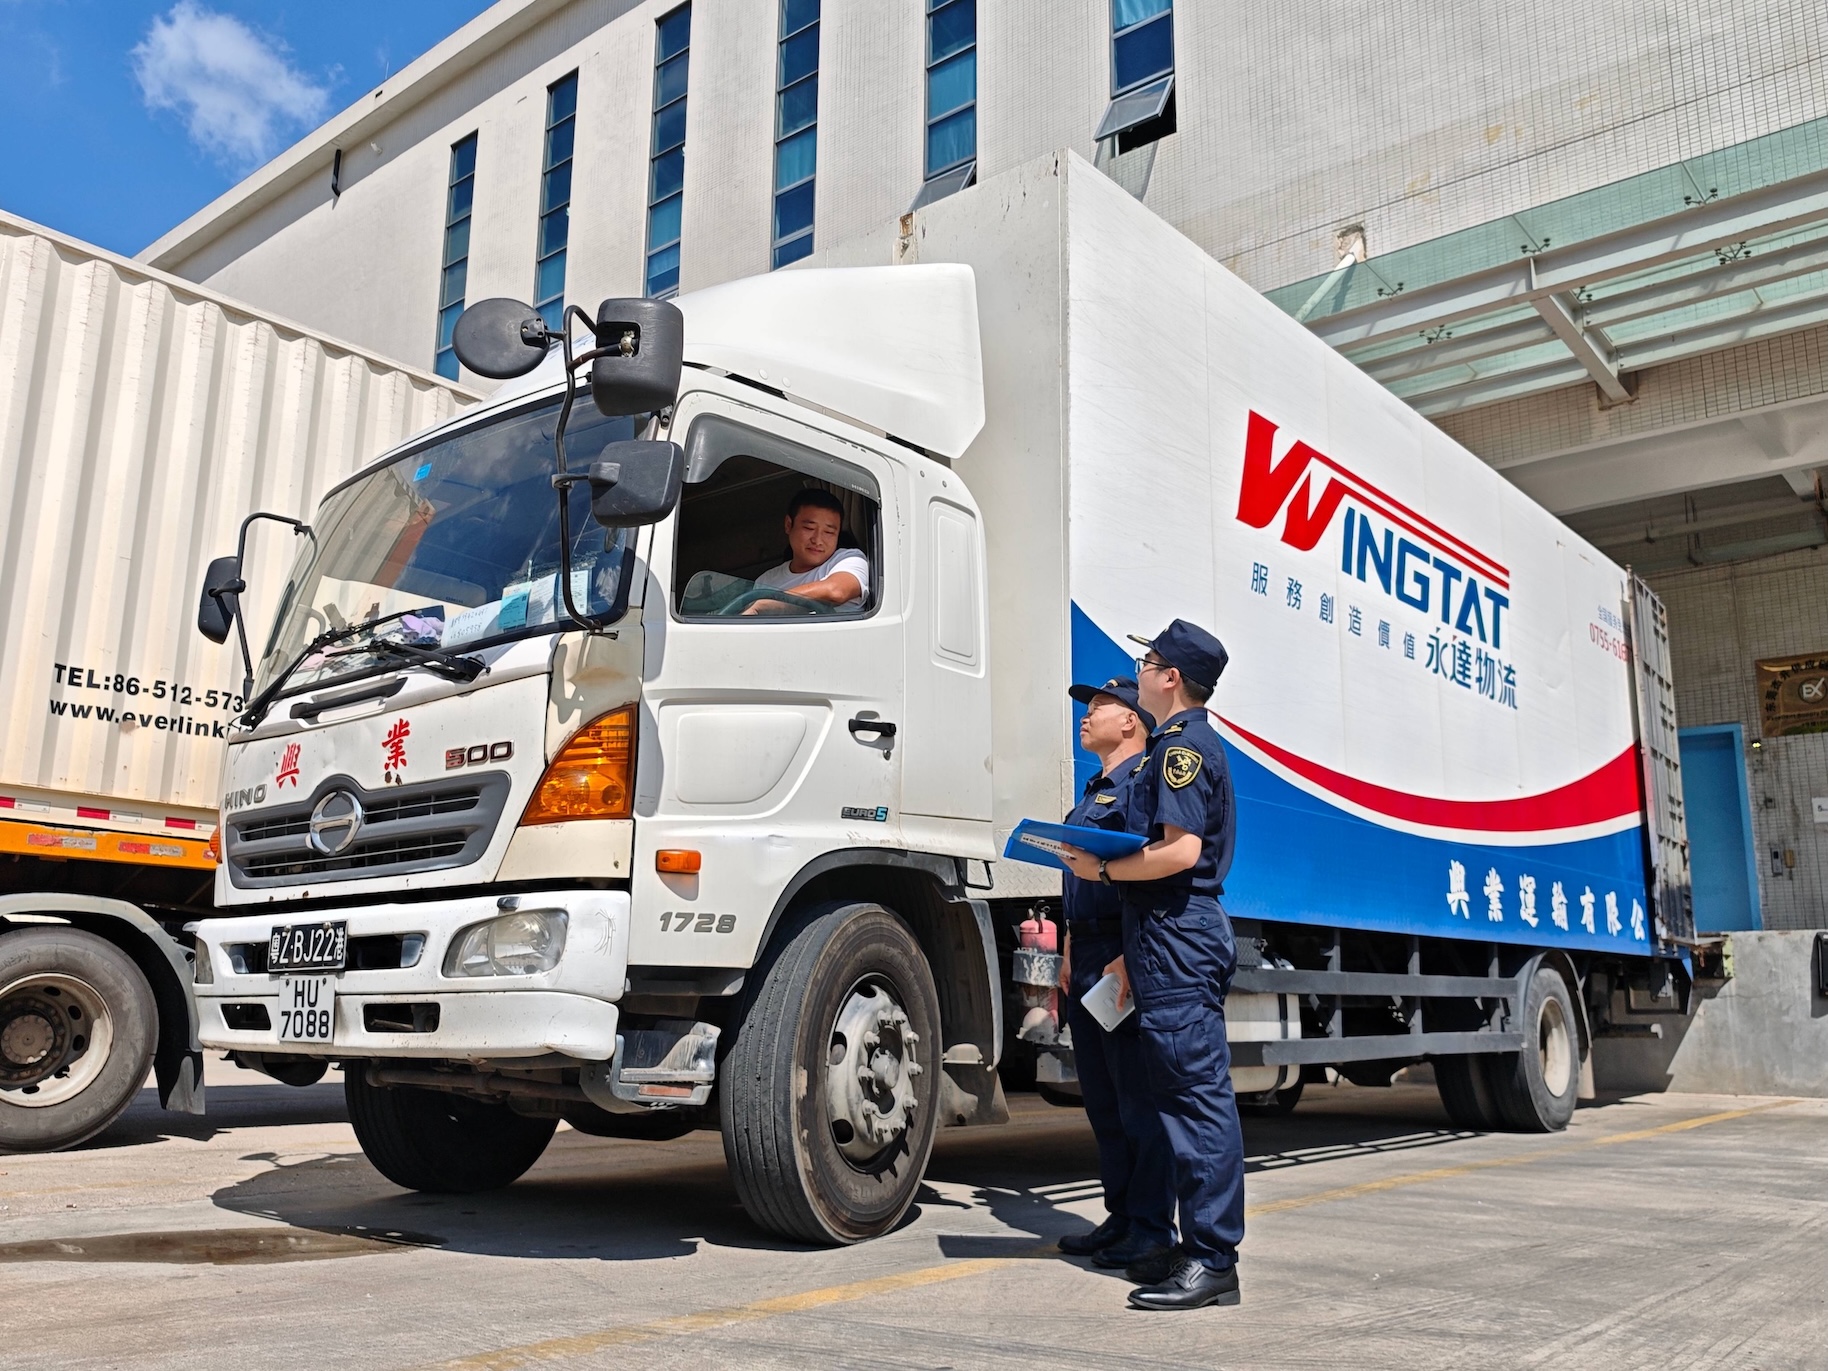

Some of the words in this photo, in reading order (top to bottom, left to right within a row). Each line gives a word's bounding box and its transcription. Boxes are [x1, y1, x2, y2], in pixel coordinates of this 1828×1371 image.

[1236, 409, 1510, 650] WINGTAT
[1250, 561, 1416, 660] 服務創造價值
[1425, 626, 1518, 710] 永達物流
[445, 740, 515, 771] 500
[224, 783, 268, 810] HINO
[659, 911, 737, 934] 1728
[294, 979, 319, 1008] HU
[281, 1010, 330, 1039] 7088
